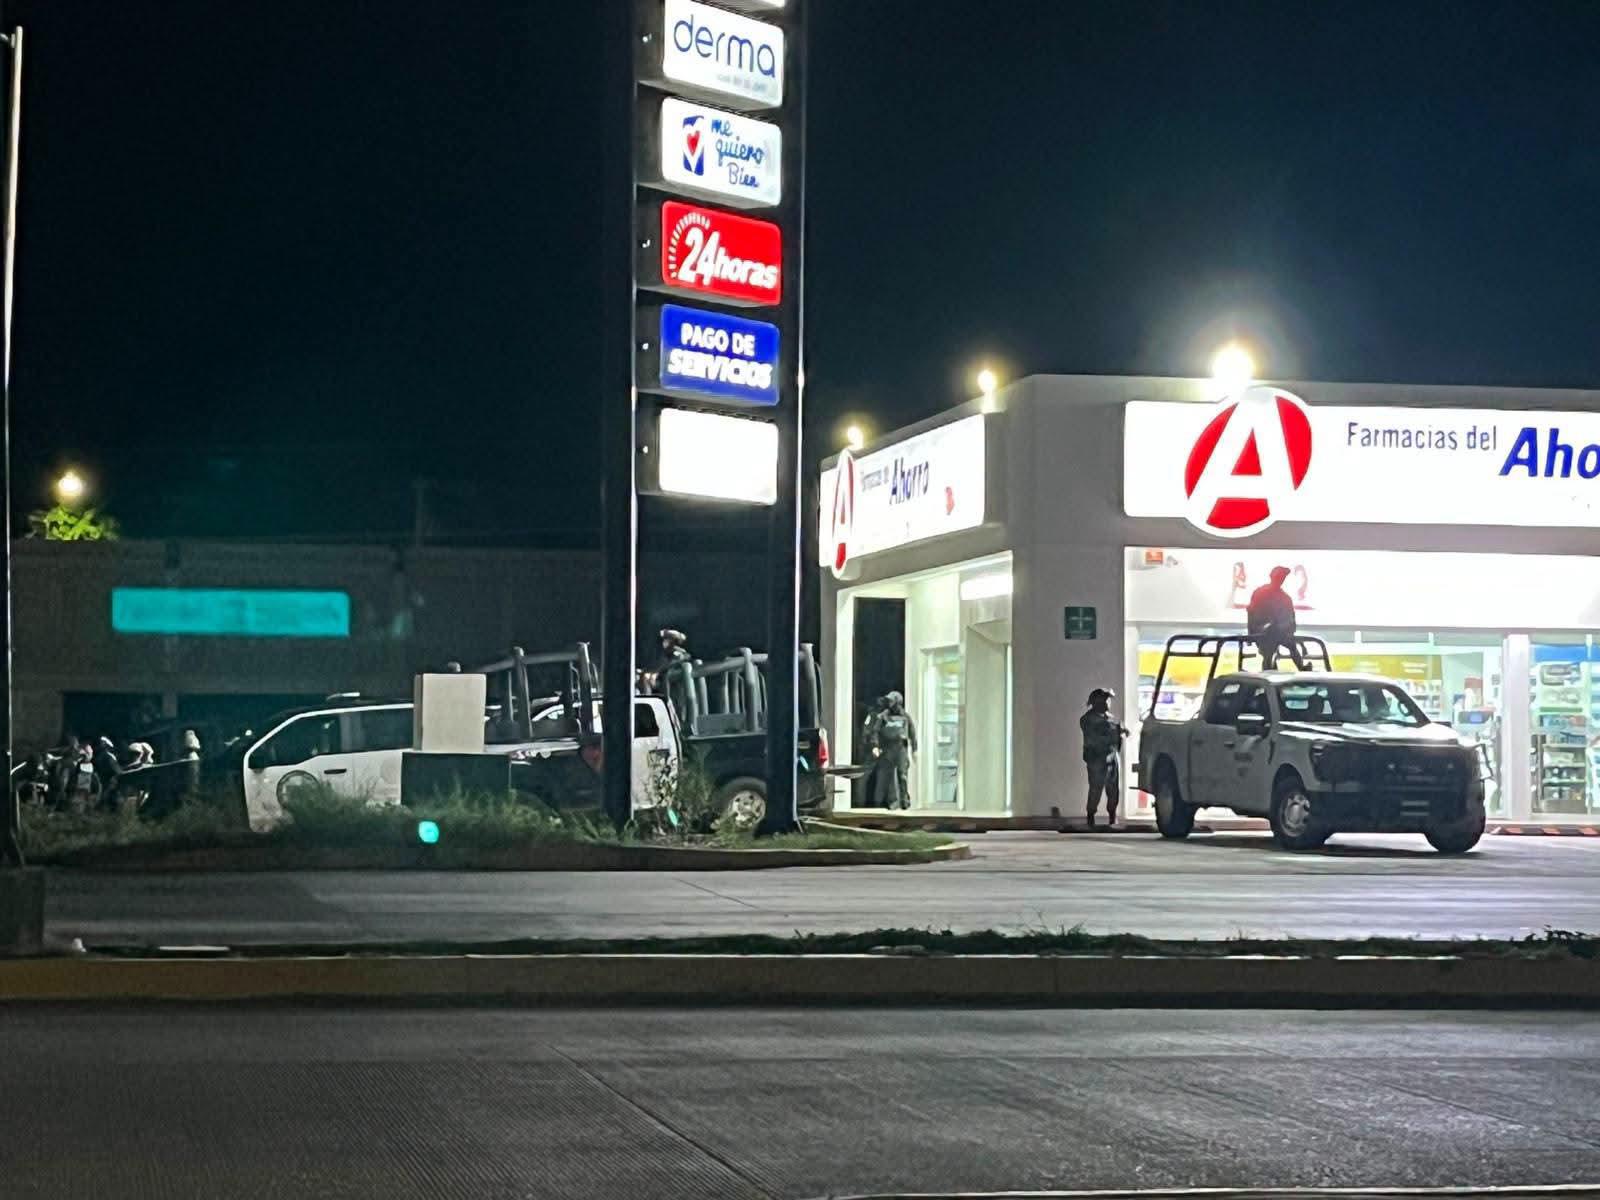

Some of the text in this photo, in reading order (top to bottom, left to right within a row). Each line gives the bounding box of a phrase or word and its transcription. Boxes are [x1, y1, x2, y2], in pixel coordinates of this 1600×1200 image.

[673, 14, 775, 77] derma
[711, 119, 732, 136] me
[715, 136, 764, 167] quiero
[727, 161, 759, 188] Bien
[681, 322, 756, 357] PAGO DE
[1347, 421, 1600, 479] Farmacias del Aho
[888, 457, 929, 505] Ahorro
